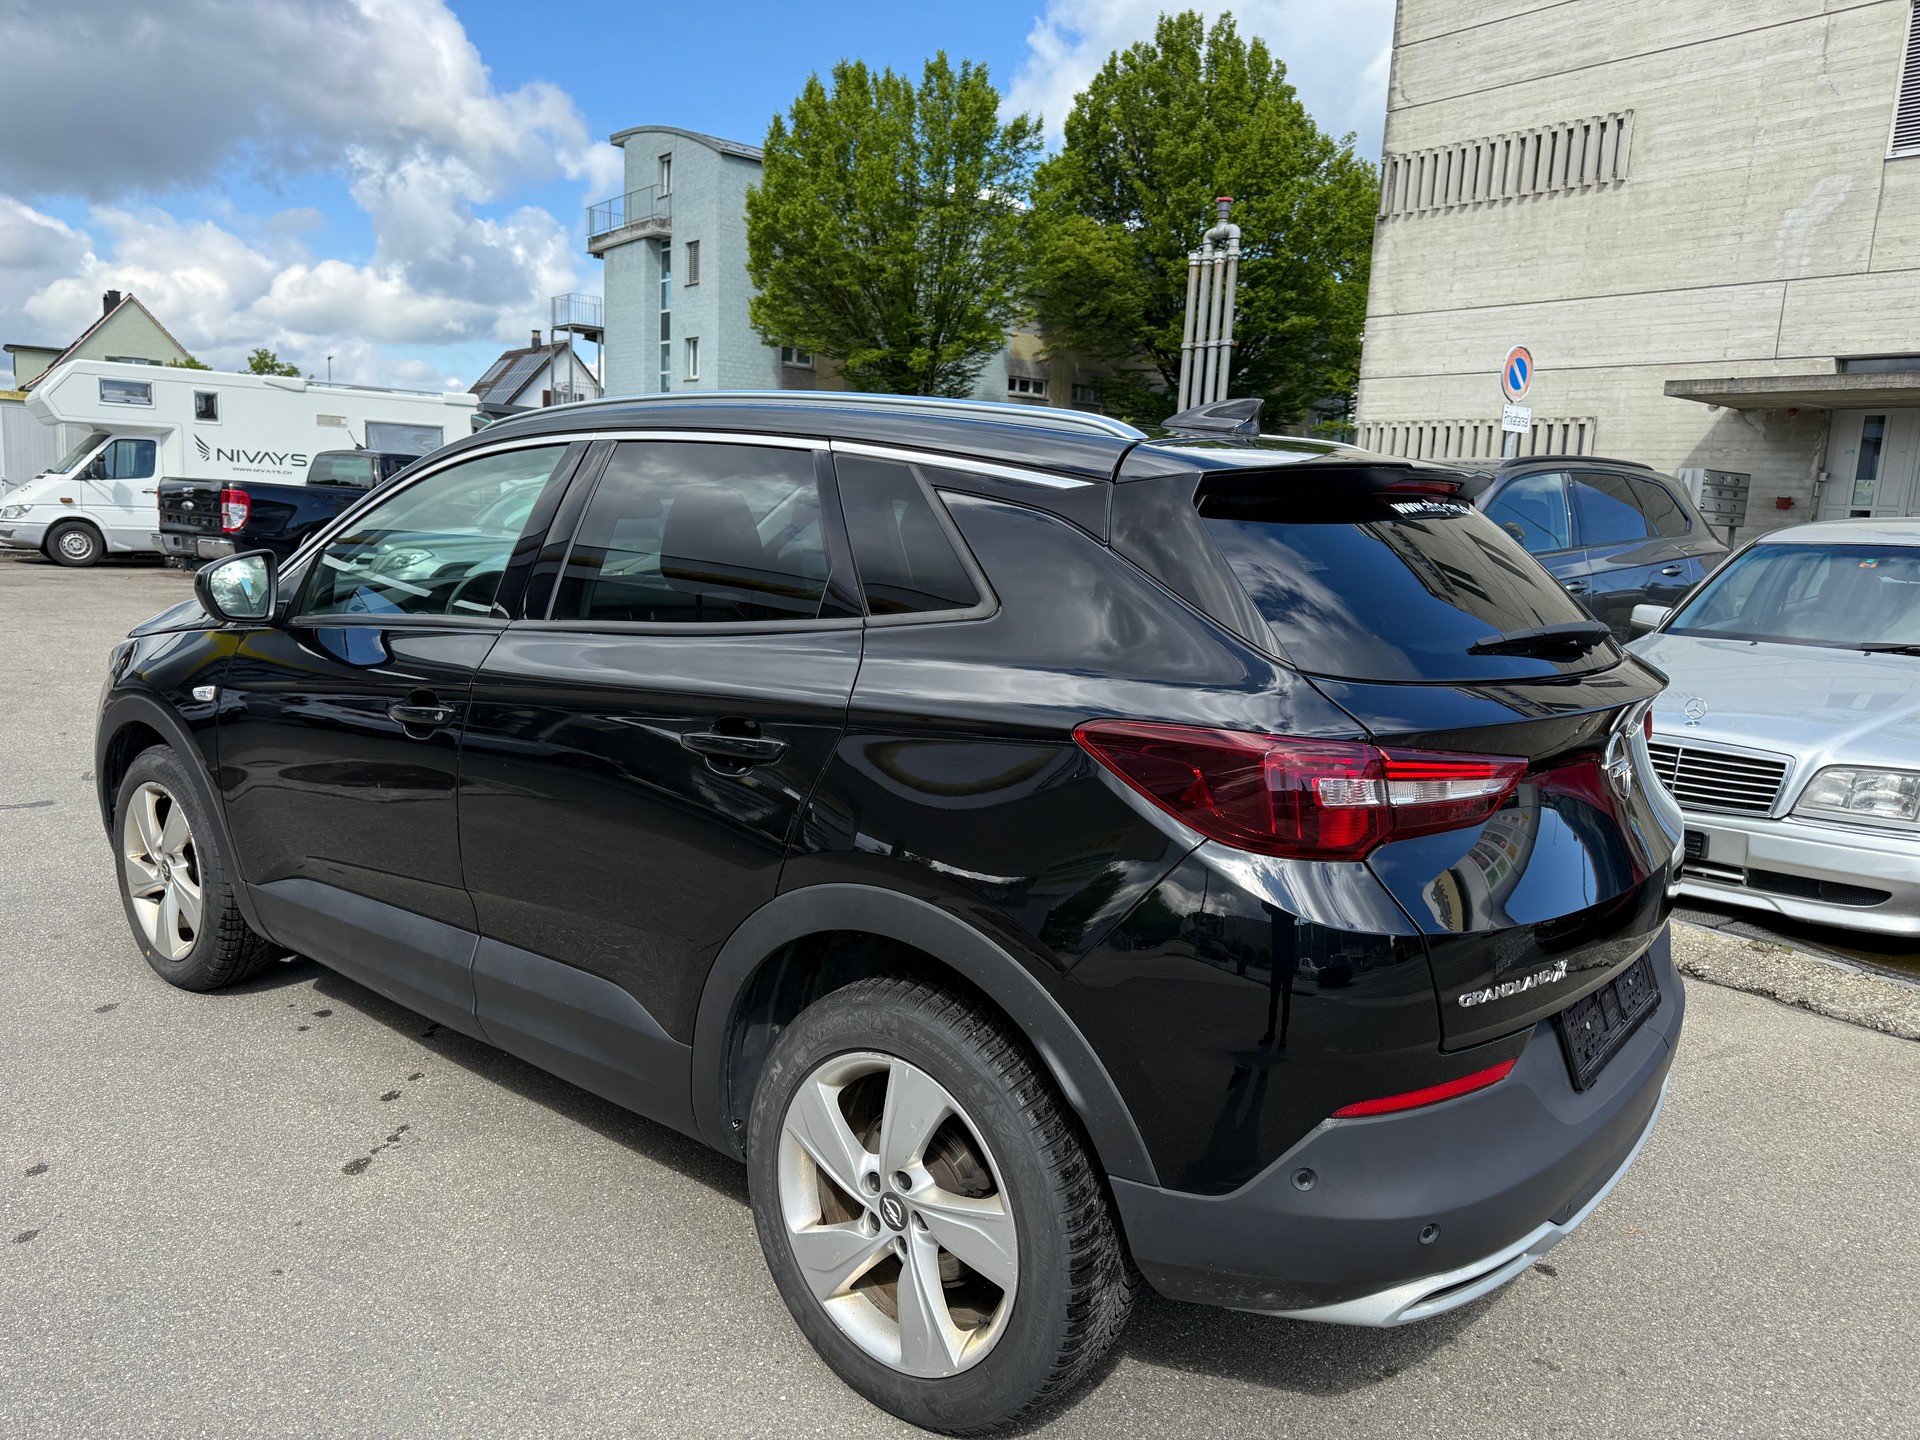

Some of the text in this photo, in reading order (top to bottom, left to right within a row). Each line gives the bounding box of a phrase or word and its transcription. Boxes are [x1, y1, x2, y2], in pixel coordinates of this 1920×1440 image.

[216, 447, 308, 467] NIVAYS
[1458, 969, 1554, 1008] GRANDLAND
[749, 1059, 783, 1160] NEXEN
